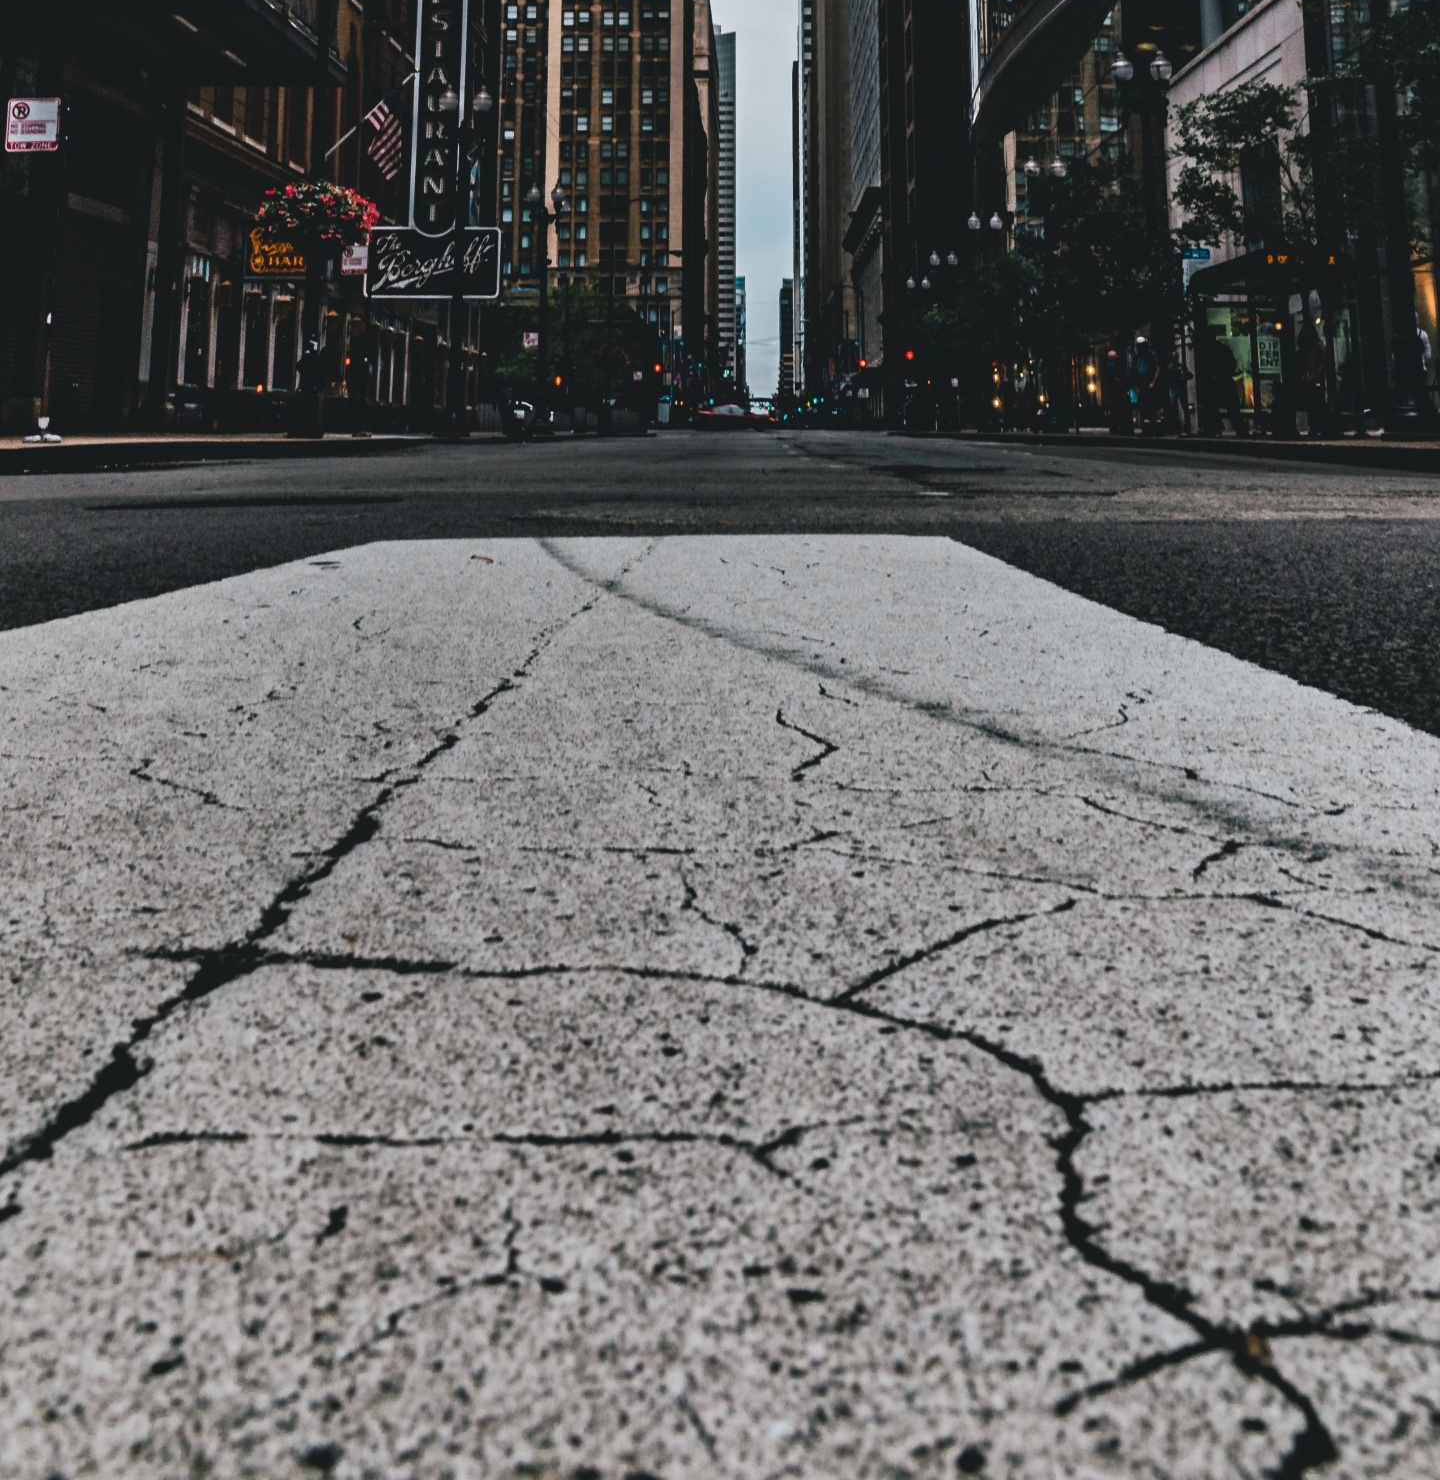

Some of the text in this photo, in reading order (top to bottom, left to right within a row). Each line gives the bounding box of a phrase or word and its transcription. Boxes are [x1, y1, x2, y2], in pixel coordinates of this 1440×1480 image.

[31, 141, 51, 149] ZONE
[376, 232, 402, 254] The
[268, 256, 304, 266] BAR
[371, 234, 494, 292] Berghff
